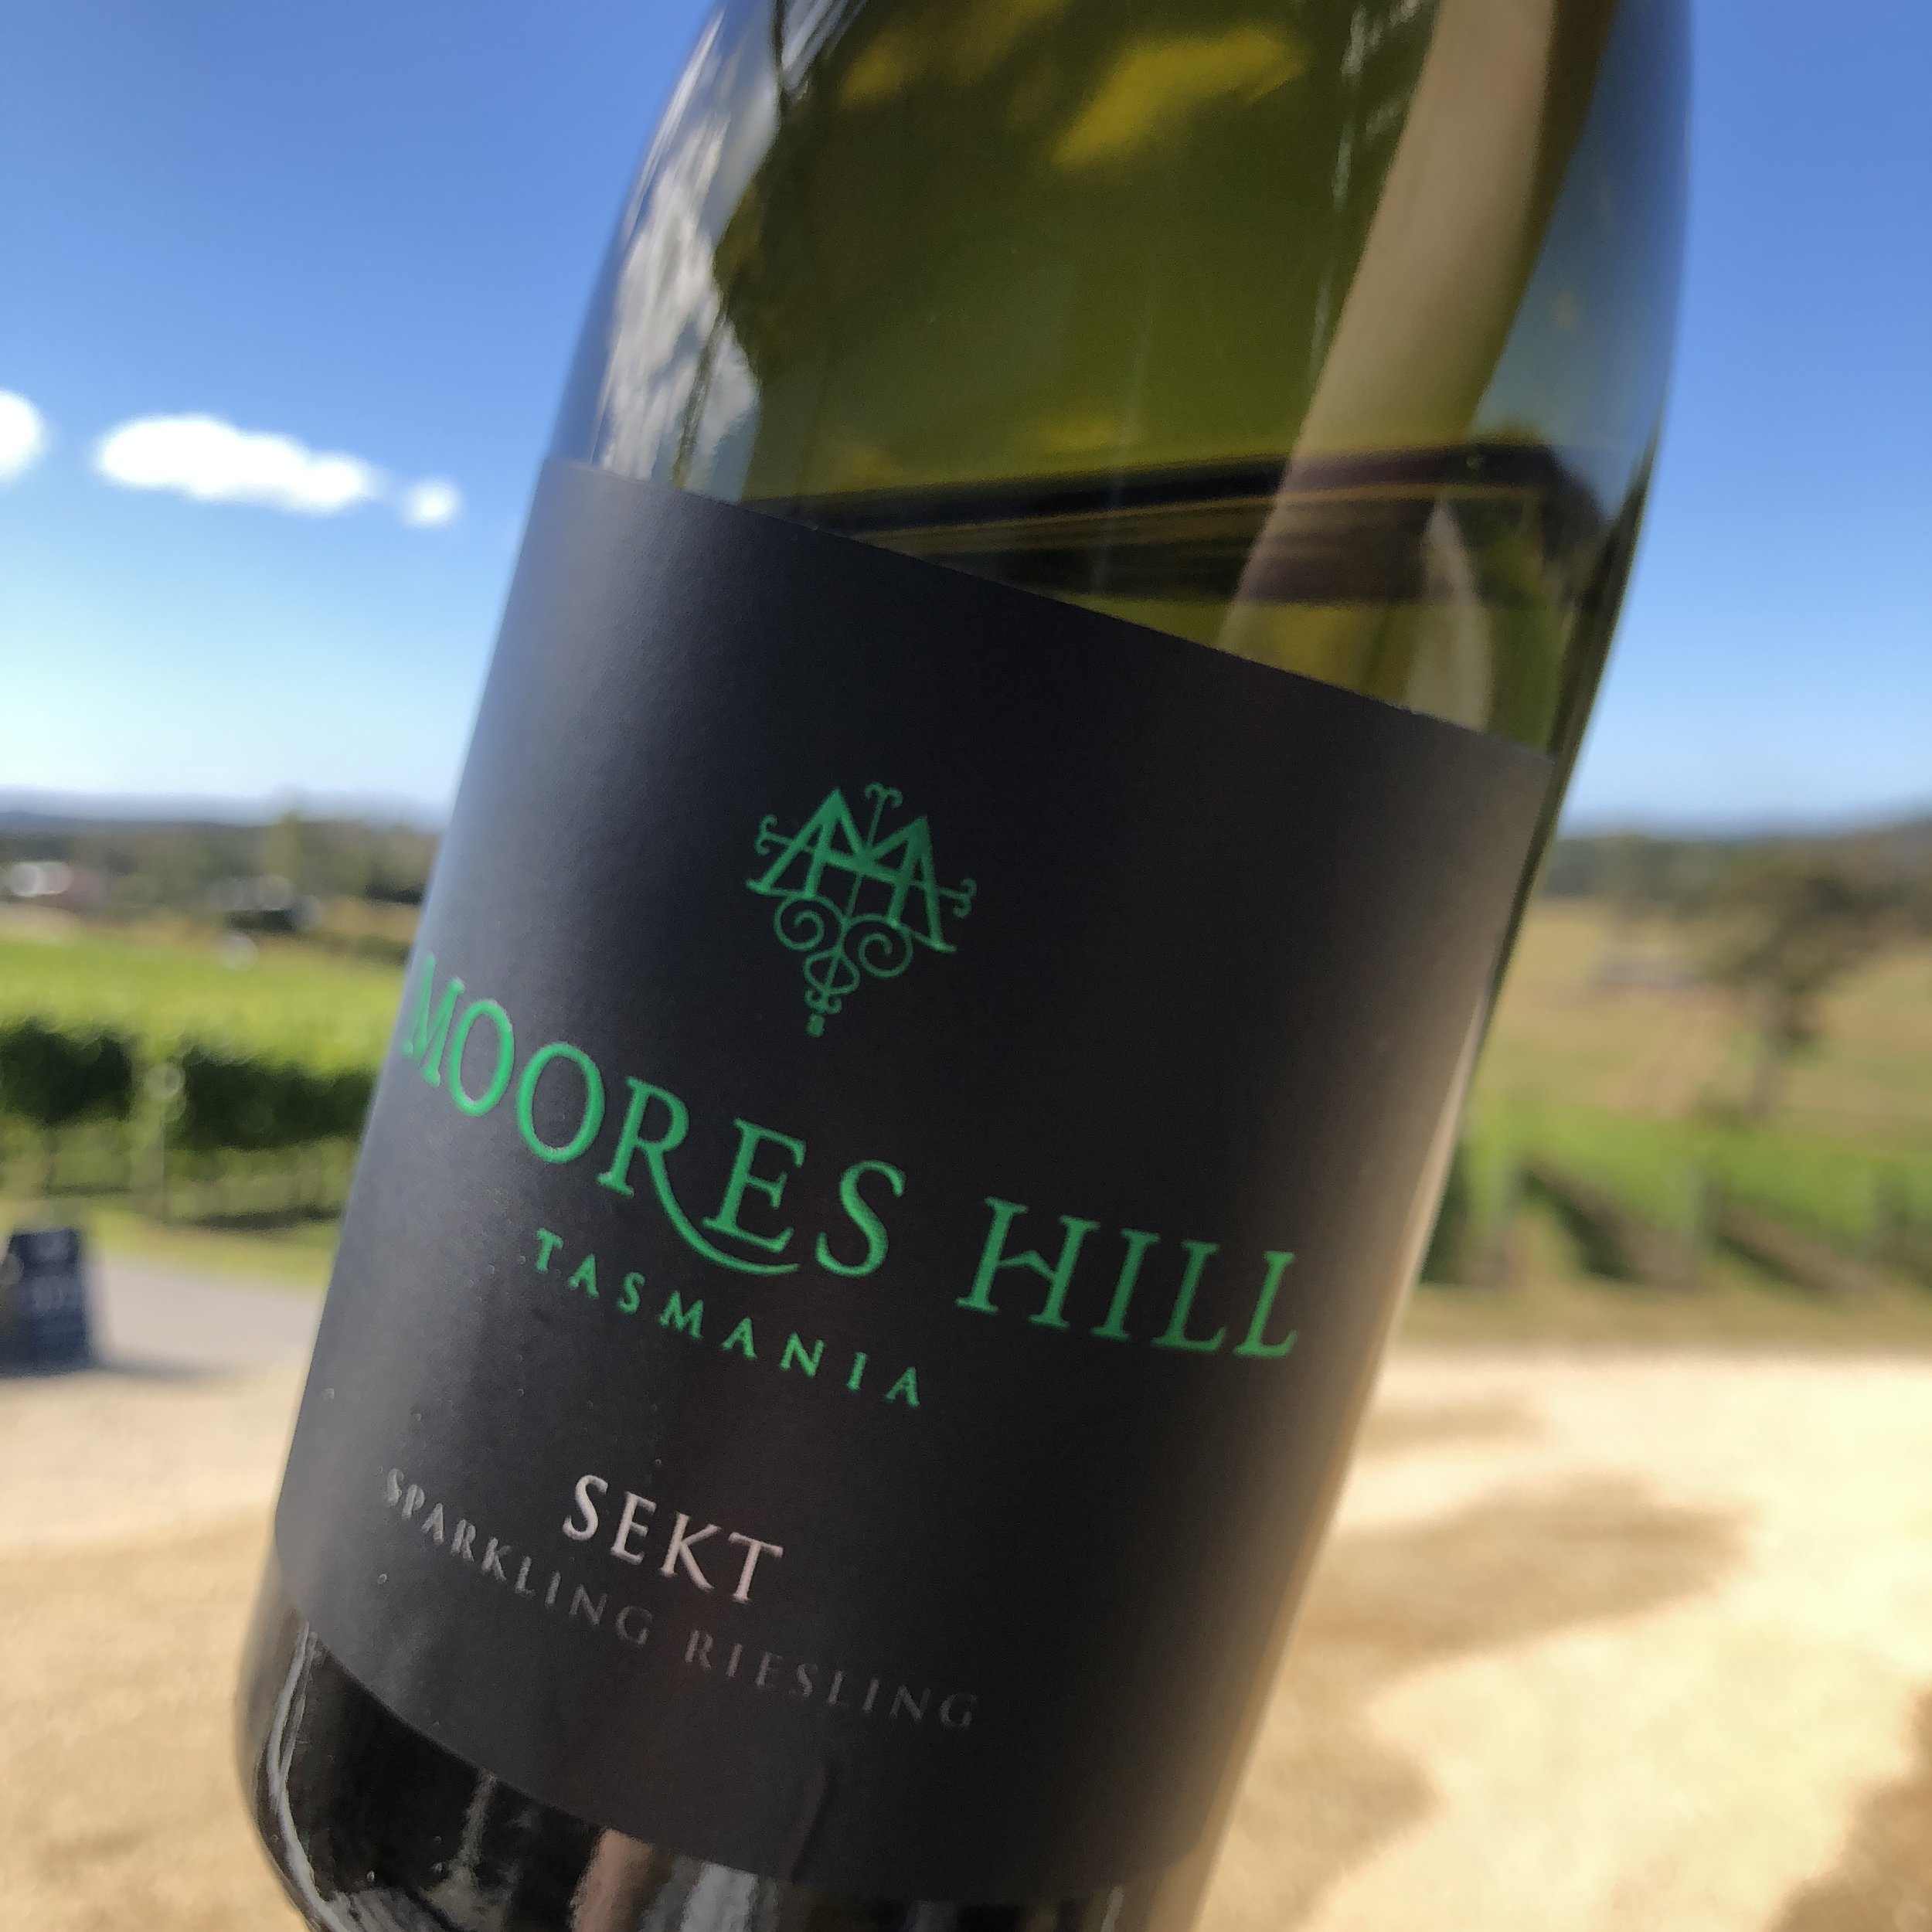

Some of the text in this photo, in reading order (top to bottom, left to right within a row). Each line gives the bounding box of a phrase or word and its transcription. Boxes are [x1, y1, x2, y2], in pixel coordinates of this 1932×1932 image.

[401, 954, 1298, 1358] MOORES HILL
[536, 1227, 920, 1407] TASMANIA
[384, 1468, 978, 1729] SPARKLING RIESLING
[563, 1475, 784, 1604] SEKT
